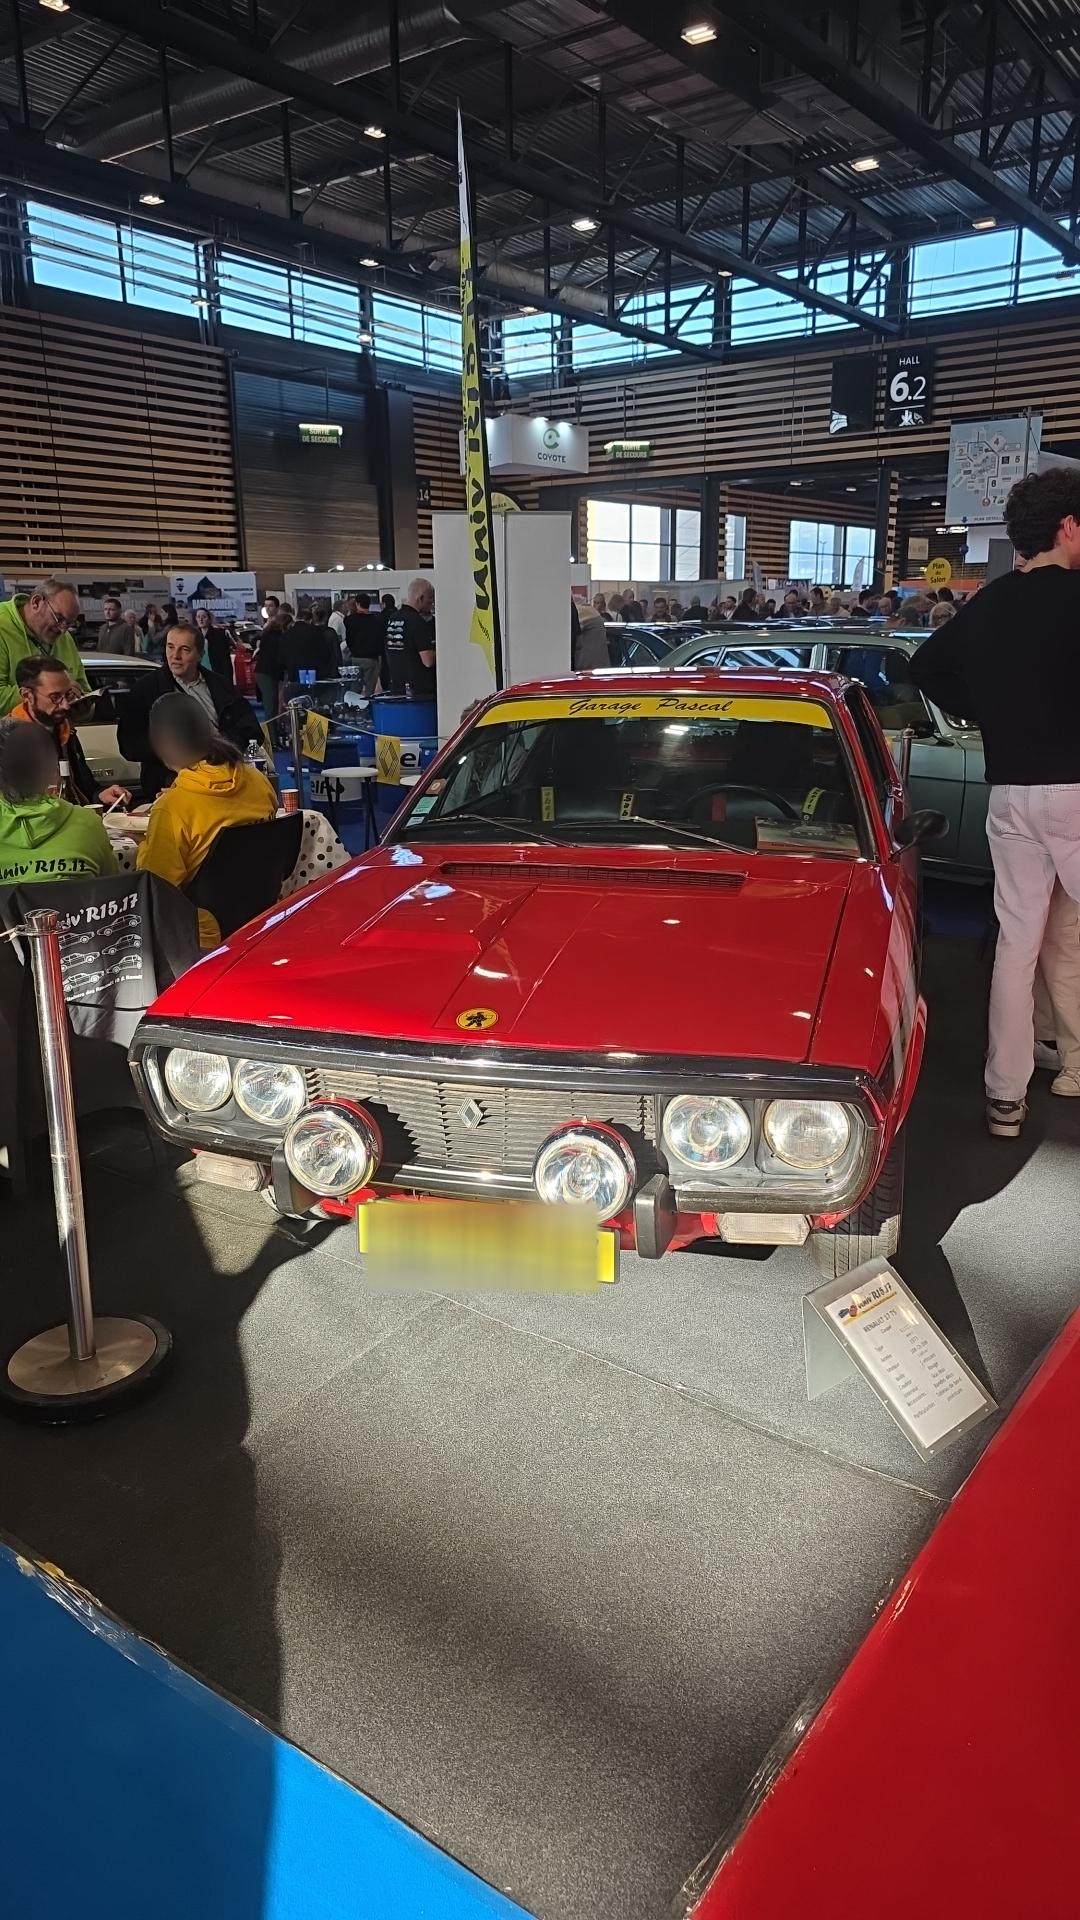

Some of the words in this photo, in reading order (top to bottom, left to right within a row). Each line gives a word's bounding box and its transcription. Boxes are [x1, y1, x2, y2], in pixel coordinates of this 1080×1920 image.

[898, 355, 921, 367] HALL
[889, 370, 927, 403] 6.2
[301, 435, 310, 443] DE
[310, 435, 338, 444] SECOURS
[537, 452, 567, 463] COYOTE
[615, 451, 623, 459] DE
[930, 576, 946, 584] Salon
[568, 698, 642, 716] Garage
[656, 697, 734, 712] Pascal
[862, 1316, 885, 1333] RENAULT
